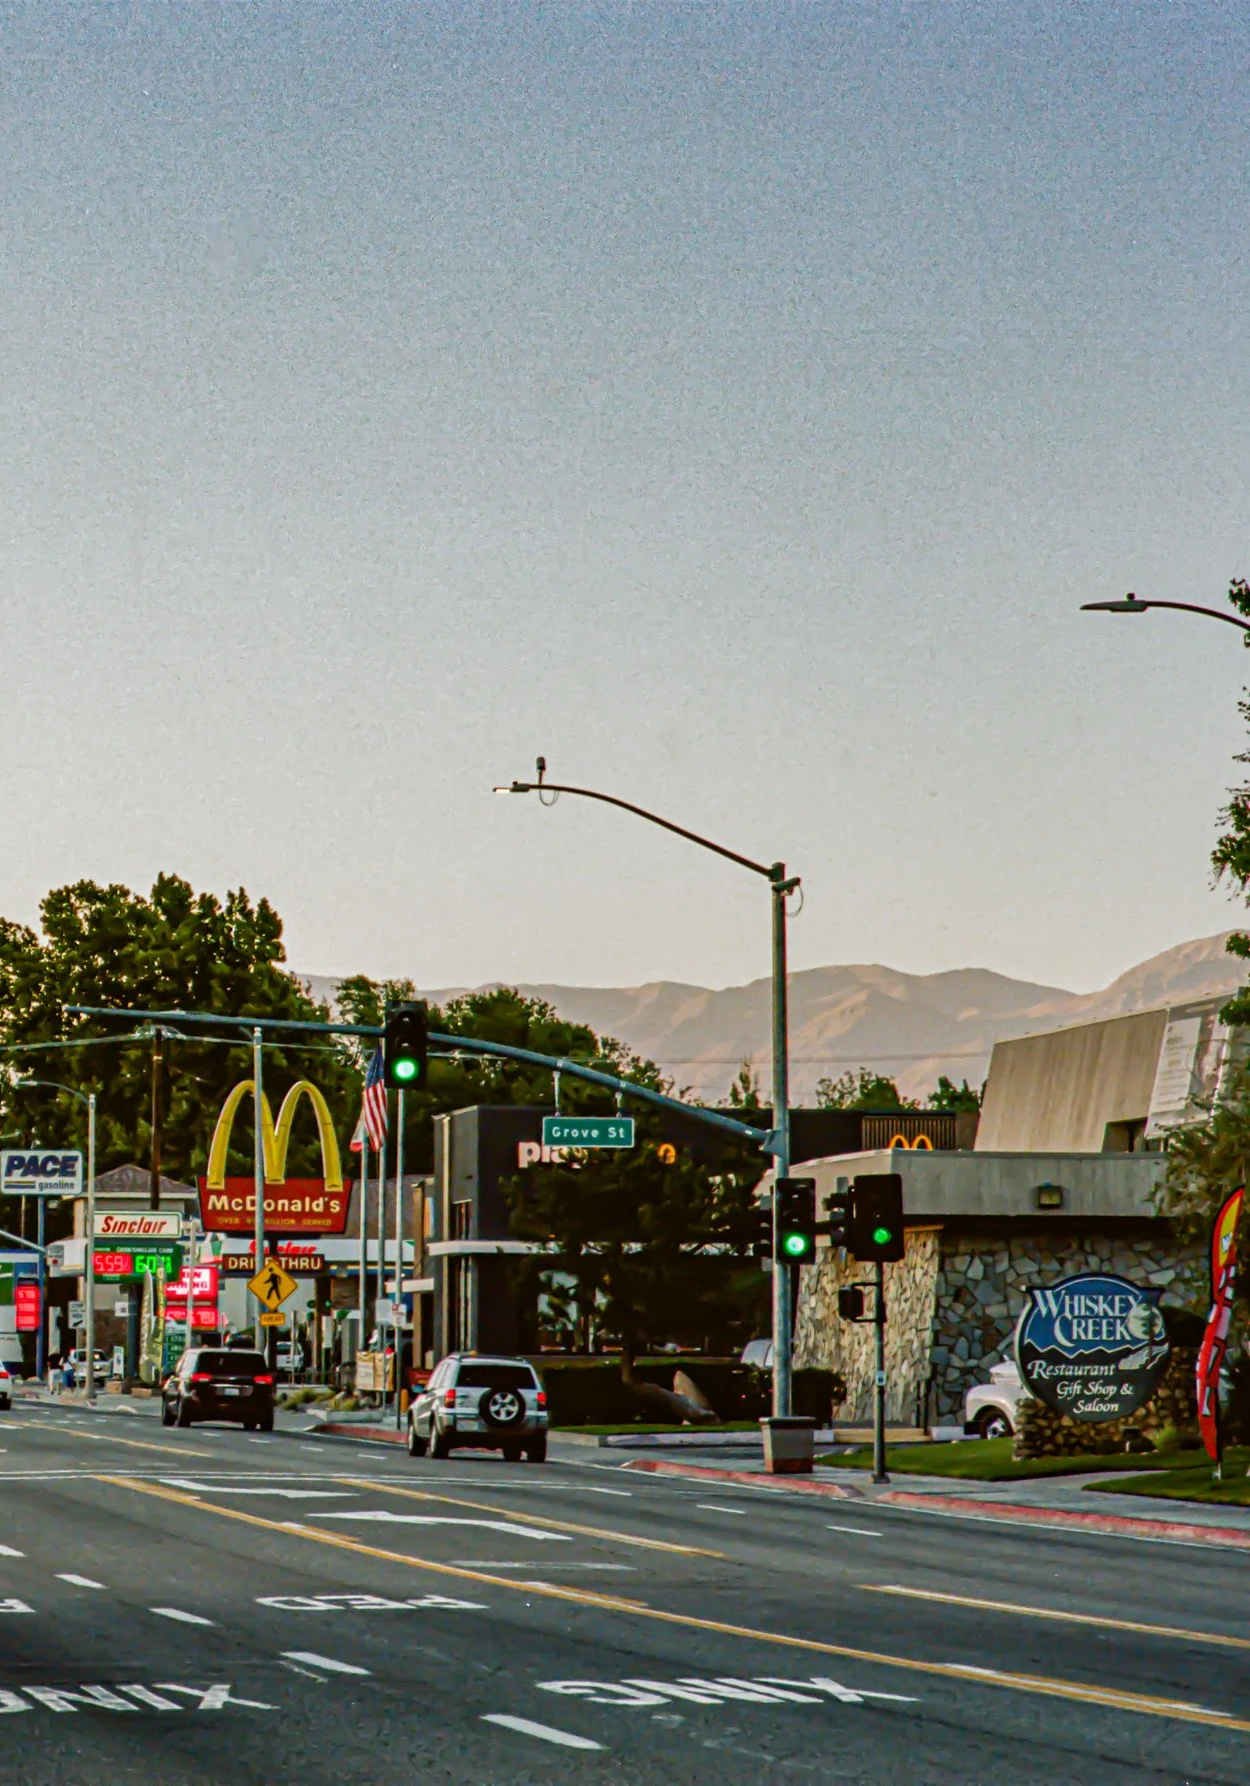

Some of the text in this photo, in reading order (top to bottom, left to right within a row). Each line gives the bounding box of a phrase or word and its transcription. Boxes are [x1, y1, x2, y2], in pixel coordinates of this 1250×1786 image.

[551, 1126, 626, 1139] Grove St
[4, 1155, 79, 1178] PACE
[38, 1180, 75, 1192] gasoline
[207, 1195, 341, 1213] McDonald's
[101, 1215, 166, 1234] Sinclair
[1033, 1290, 1142, 1319] WHISKEY
[1054, 1314, 1132, 1347] CREEK
[1027, 1360, 1116, 1379] Restaurant
[1056, 1380, 1134, 1400] Gift Shop &
[1072, 1398, 1119, 1414] Saloon
